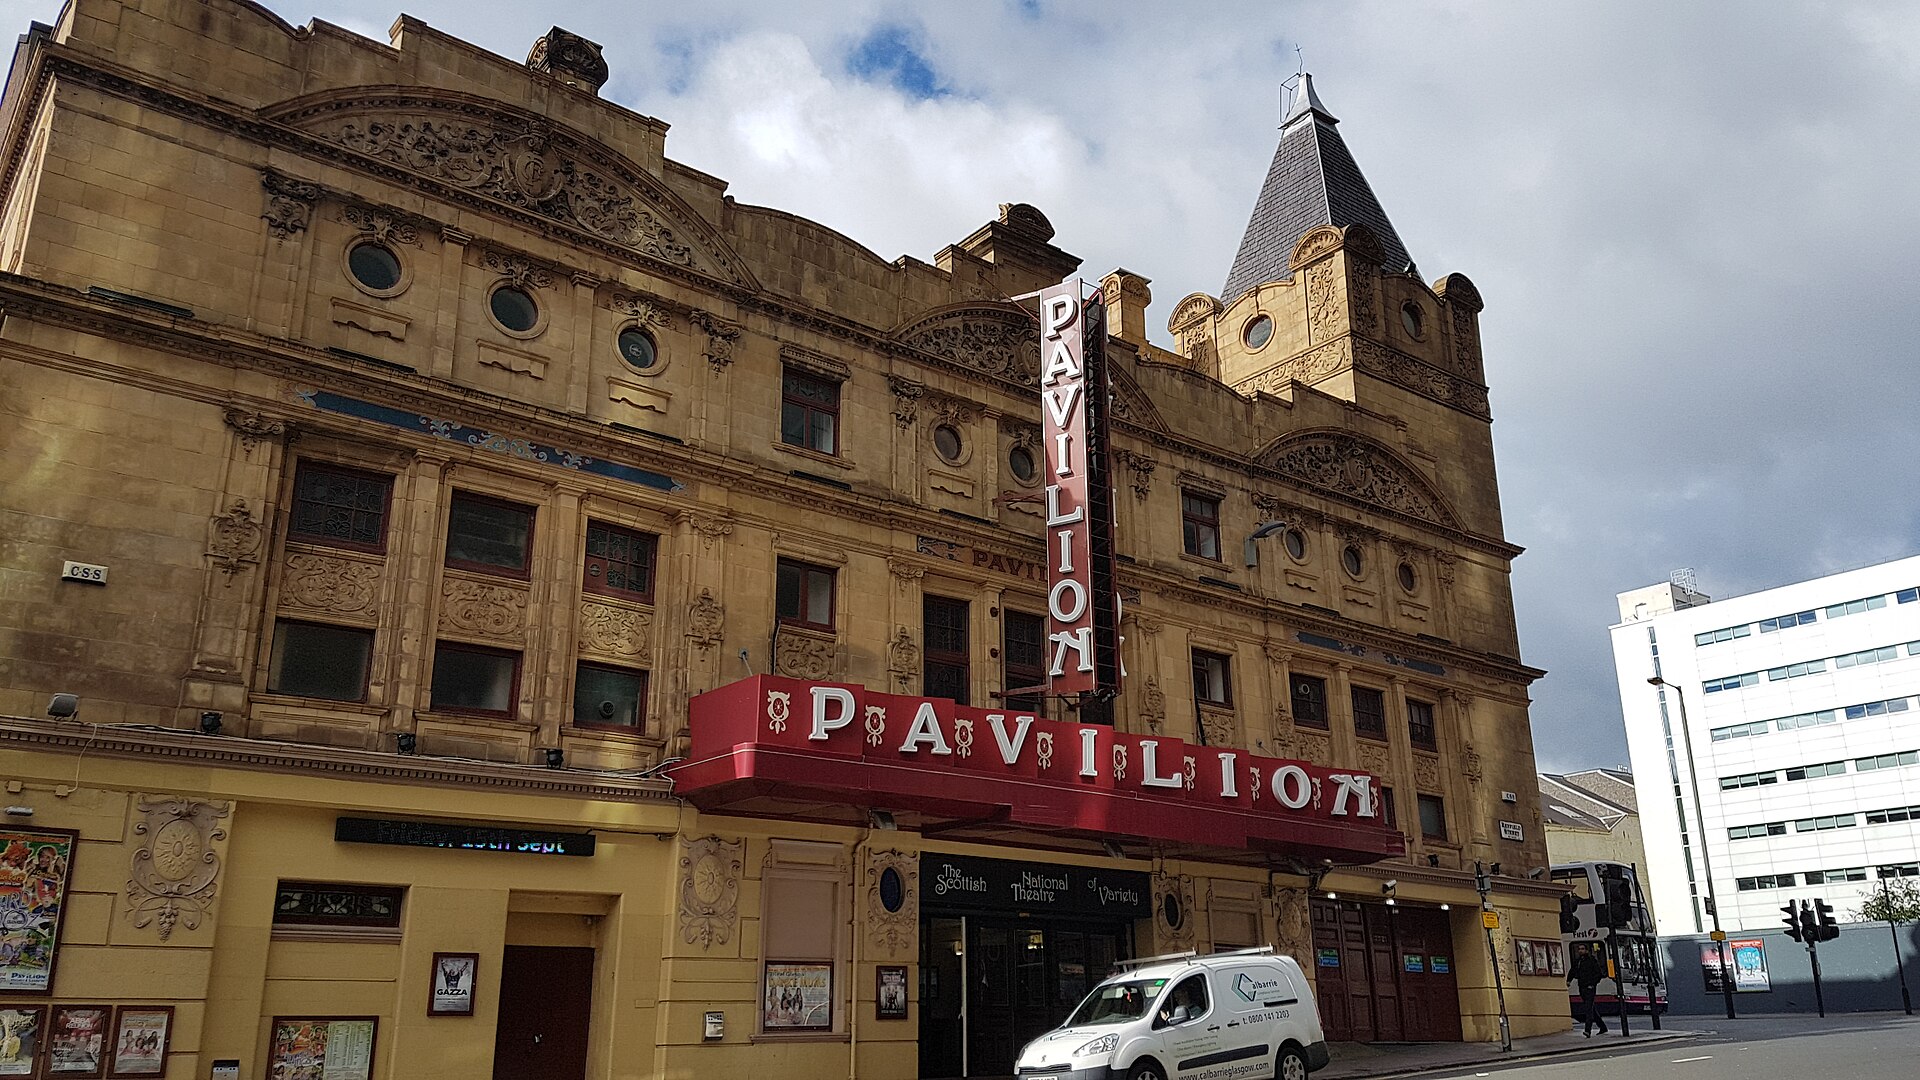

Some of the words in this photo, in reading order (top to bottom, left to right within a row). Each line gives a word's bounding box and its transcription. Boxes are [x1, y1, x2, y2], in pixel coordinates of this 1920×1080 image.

[1042, 293, 1093, 677] PAVILION
[808, 685, 1374, 818] PAVILION
[942, 863, 962, 880] The
[1022, 871, 1069, 891] National
[935, 875, 987, 895] Scottish
[1011, 883, 1056, 903] Theatre
[1087, 877, 1098, 892] of
[1098, 886, 1139, 906] Variety
[1572, 930, 1588, 938] First
[437, 988, 467, 996] GAZZA
[1248, 1014, 1264, 1024] 0800
[1265, 1012, 1275, 1021] 141
[1276, 1009, 1290, 1020] 2203
